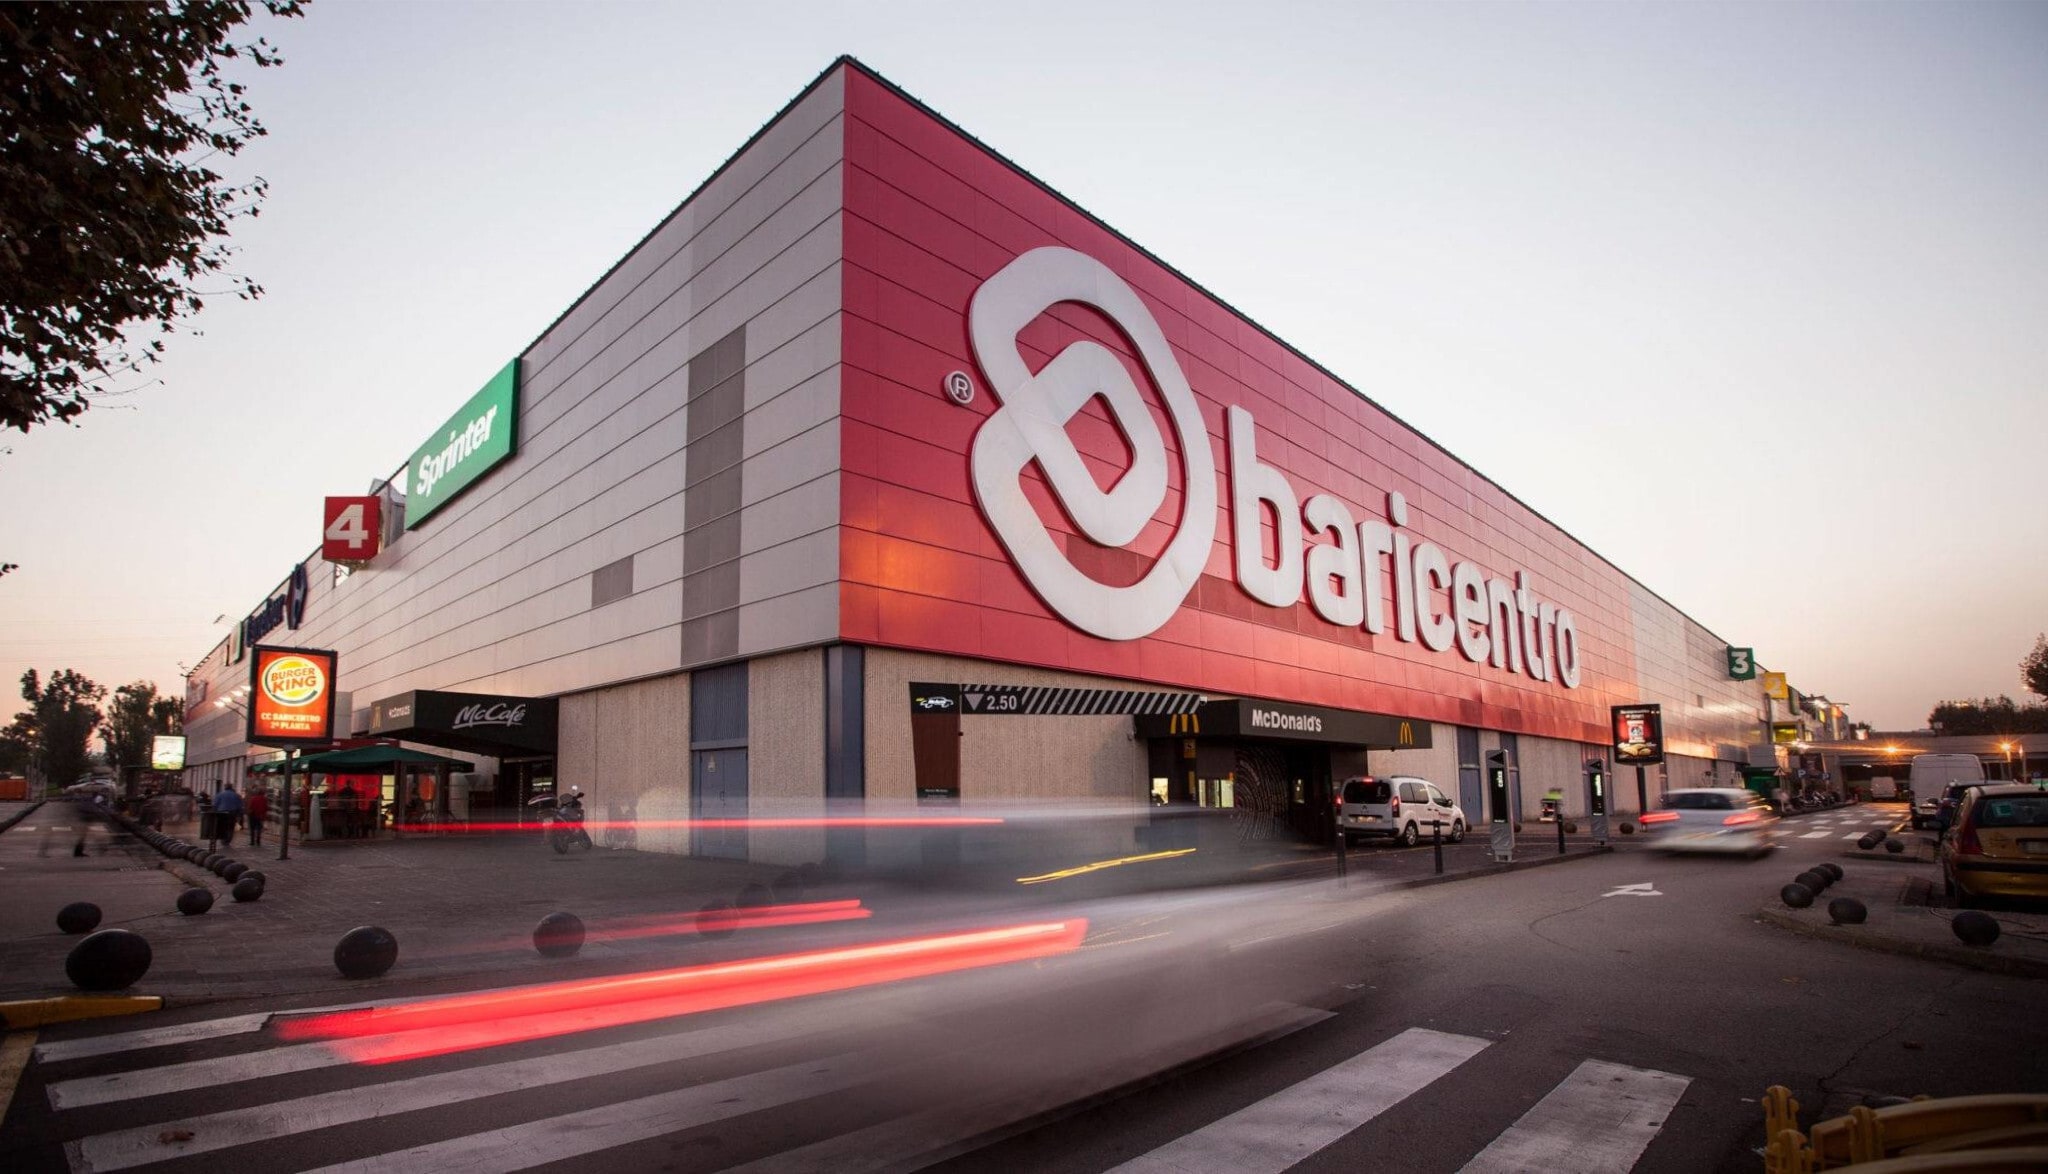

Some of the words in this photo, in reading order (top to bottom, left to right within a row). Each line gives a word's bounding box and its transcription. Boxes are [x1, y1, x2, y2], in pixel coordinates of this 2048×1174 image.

[416, 404, 498, 497] Sprinter
[325, 504, 369, 548] 4
[1228, 404, 1581, 689] baricentro
[271, 667, 315, 681] BURGER
[1731, 651, 1749, 674] 3
[272, 676, 317, 693] KING
[986, 695, 1018, 711] 2.50
[281, 722, 311, 731] PLANTA
[453, 703, 526, 729] McCafé
[1252, 709, 1322, 733] McDonald's
